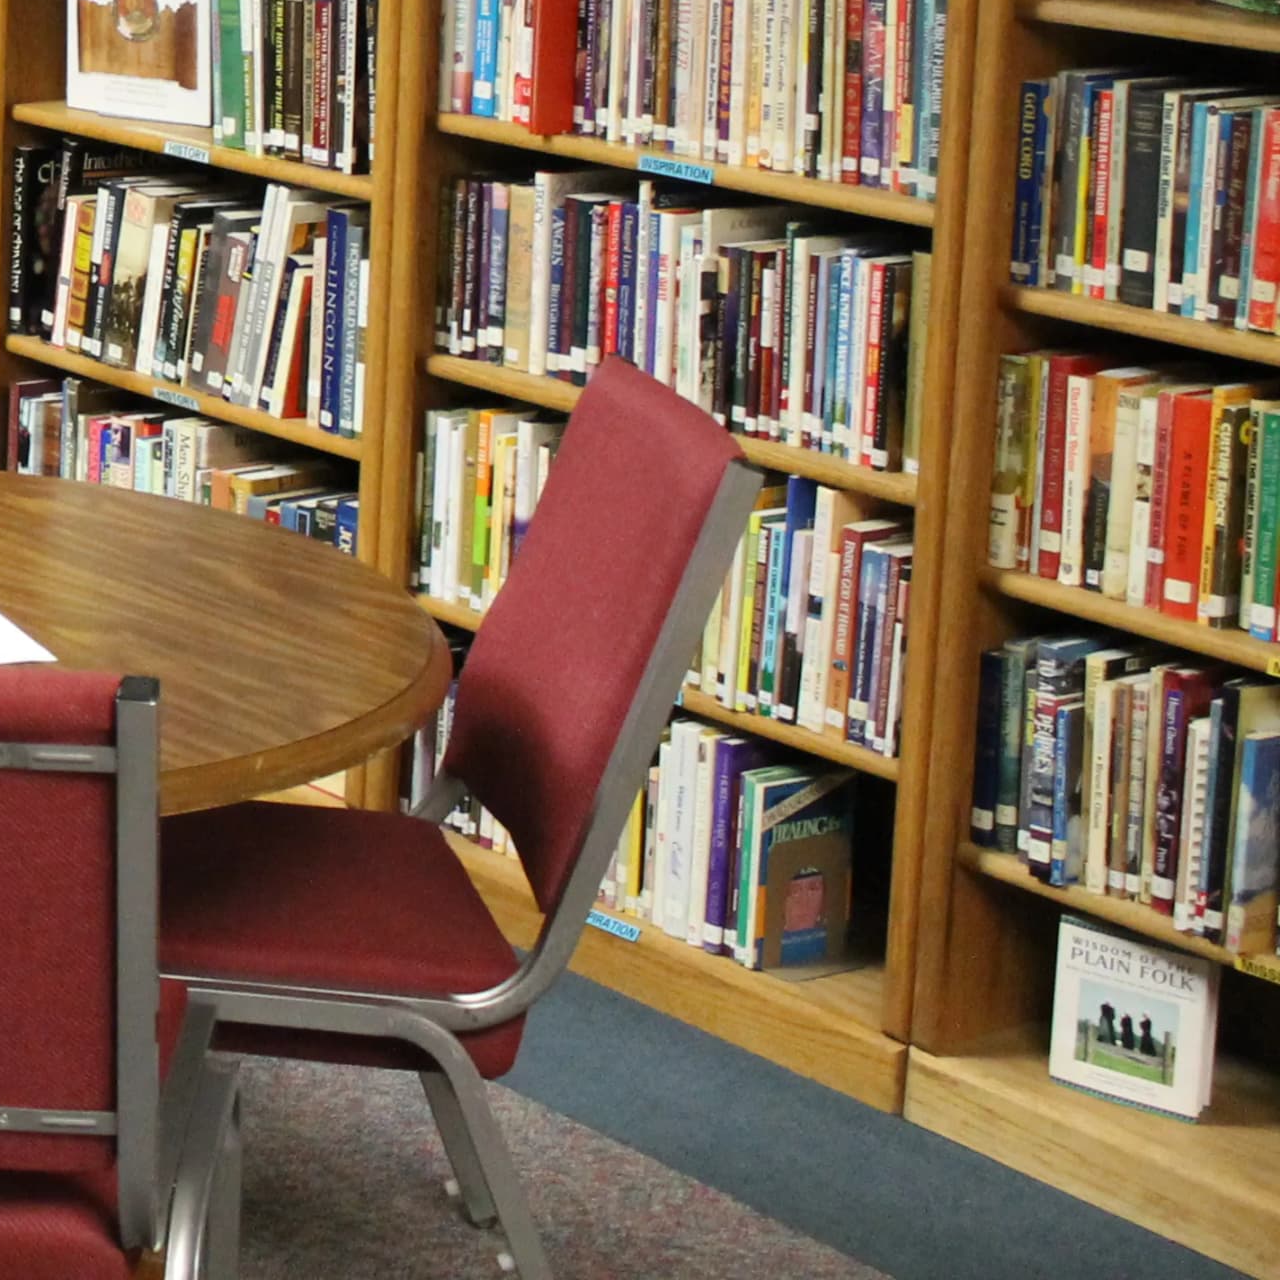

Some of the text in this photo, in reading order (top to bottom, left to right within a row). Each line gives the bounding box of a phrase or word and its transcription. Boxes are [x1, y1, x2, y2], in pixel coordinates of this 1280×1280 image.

[168, 144, 207, 162] HISTORY
[1020, 92, 1036, 179] GOLD CORD
[642, 157, 710, 180] INSPIRATION
[1159, 101, 1173, 218] The Word that Kindles
[167, 219, 179, 259] HEART
[349, 243, 359, 274] HOW
[551, 216, 566, 265] ANGELS
[620, 214, 632, 279] Changed Lives
[168, 275, 187, 349] Mayflower
[324, 269, 338, 370] LINCOLN
[345, 278, 358, 327] SHOULD
[344, 331, 355, 348] WE
[343, 352, 354, 383] THEN
[177, 434, 190, 469] Men,
[1213, 423, 1233, 527] CULTURE SHOCK
[836, 540, 855, 654] FINDING GOD AT HARVARD
[587, 912, 637, 939] PIRATION
[1071, 947, 1195, 992] PLAIN FOLK
[1072, 935, 1133, 961] WISDOM
[1139, 952, 1160, 966] OF
